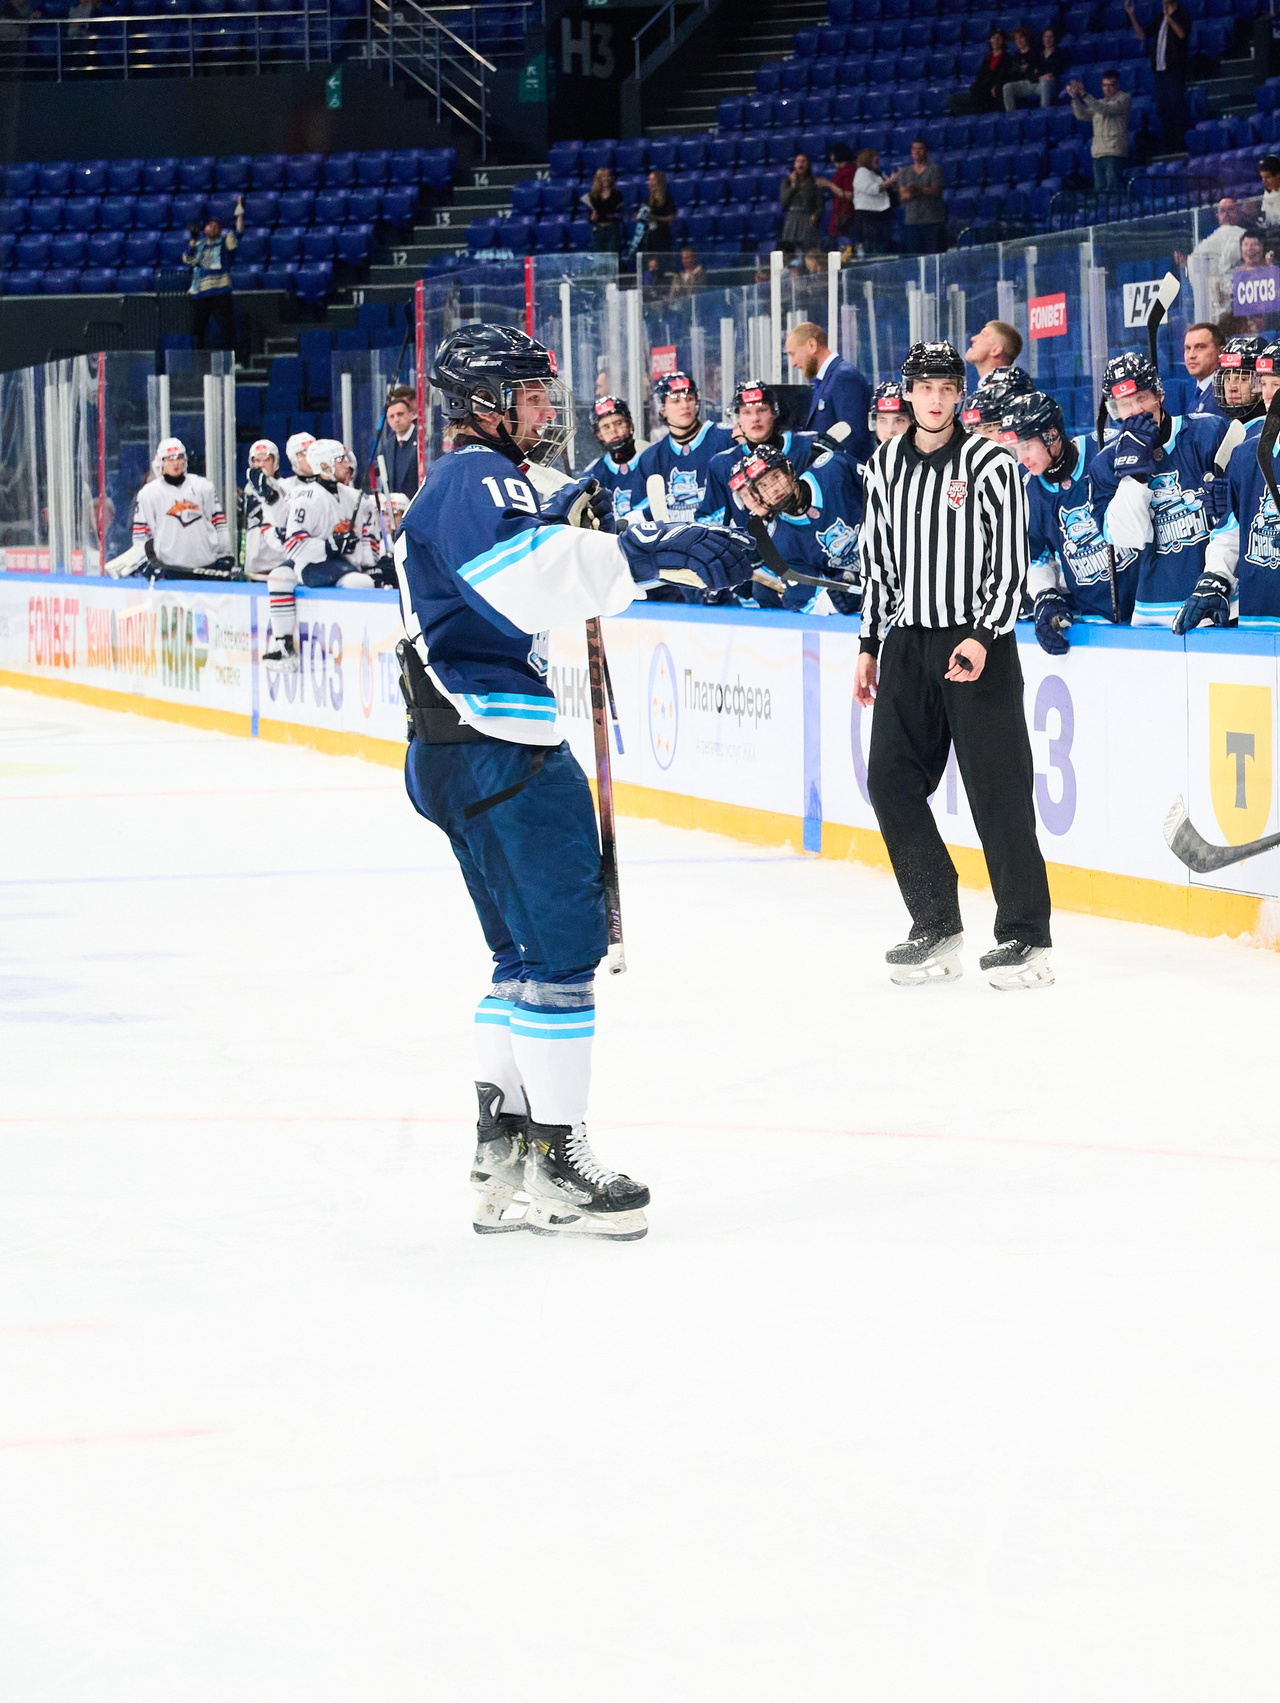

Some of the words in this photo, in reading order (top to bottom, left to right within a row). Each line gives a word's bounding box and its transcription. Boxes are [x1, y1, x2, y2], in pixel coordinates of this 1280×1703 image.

[474, 173, 489, 187] 14
[1029, 302, 1066, 331] FONBET
[1114, 366, 1126, 380] 12
[470, 394, 497, 409] BAUER
[481, 476, 539, 515] 19
[28, 597, 80, 670] FONBET
[551, 666, 591, 720] АНК
[684, 668, 772, 731] Платосфера
